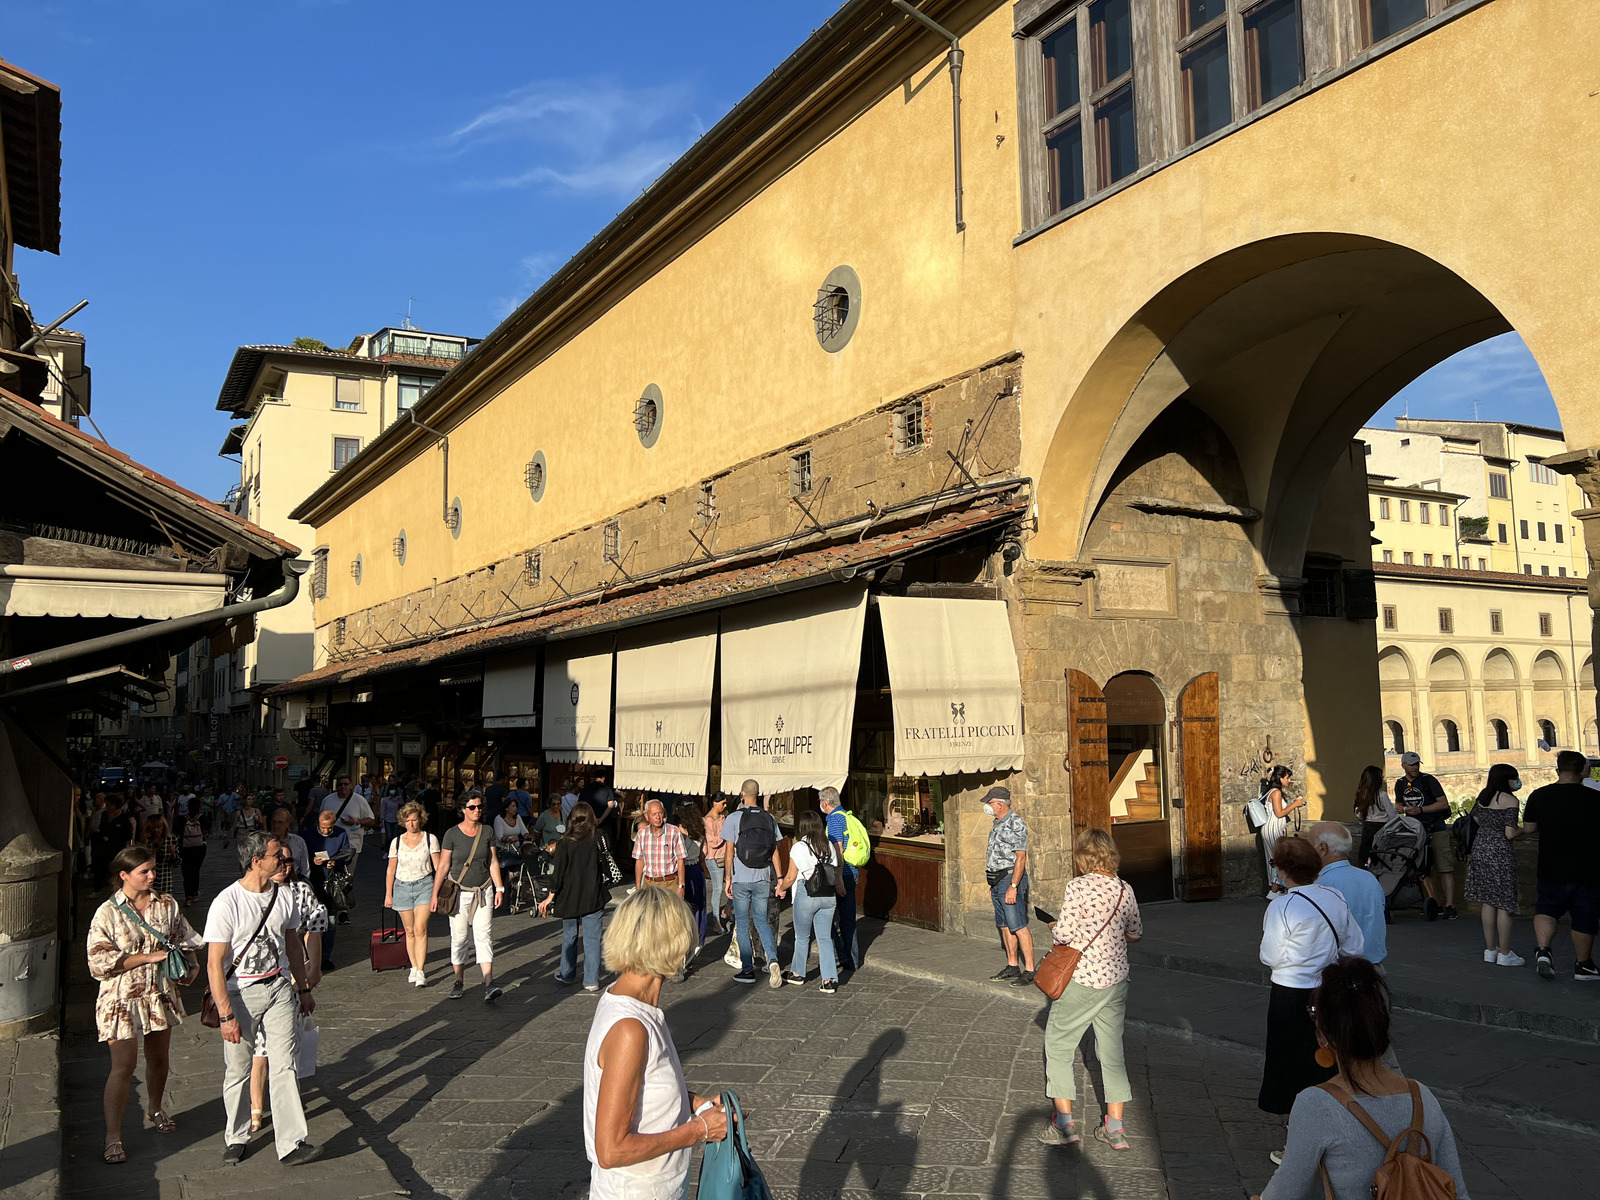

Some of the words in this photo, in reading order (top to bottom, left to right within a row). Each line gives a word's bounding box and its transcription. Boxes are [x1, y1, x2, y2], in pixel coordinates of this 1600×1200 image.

[905, 727, 965, 739] FRATELLI
[968, 725, 1015, 737] PICCINI
[625, 743, 661, 758] FRATELLI
[662, 742, 695, 758] PICCINI
[748, 738, 772, 755] PATEK
[774, 735, 813, 754] PHILIPPE
[650, 758, 665, 766] FIRENZE
